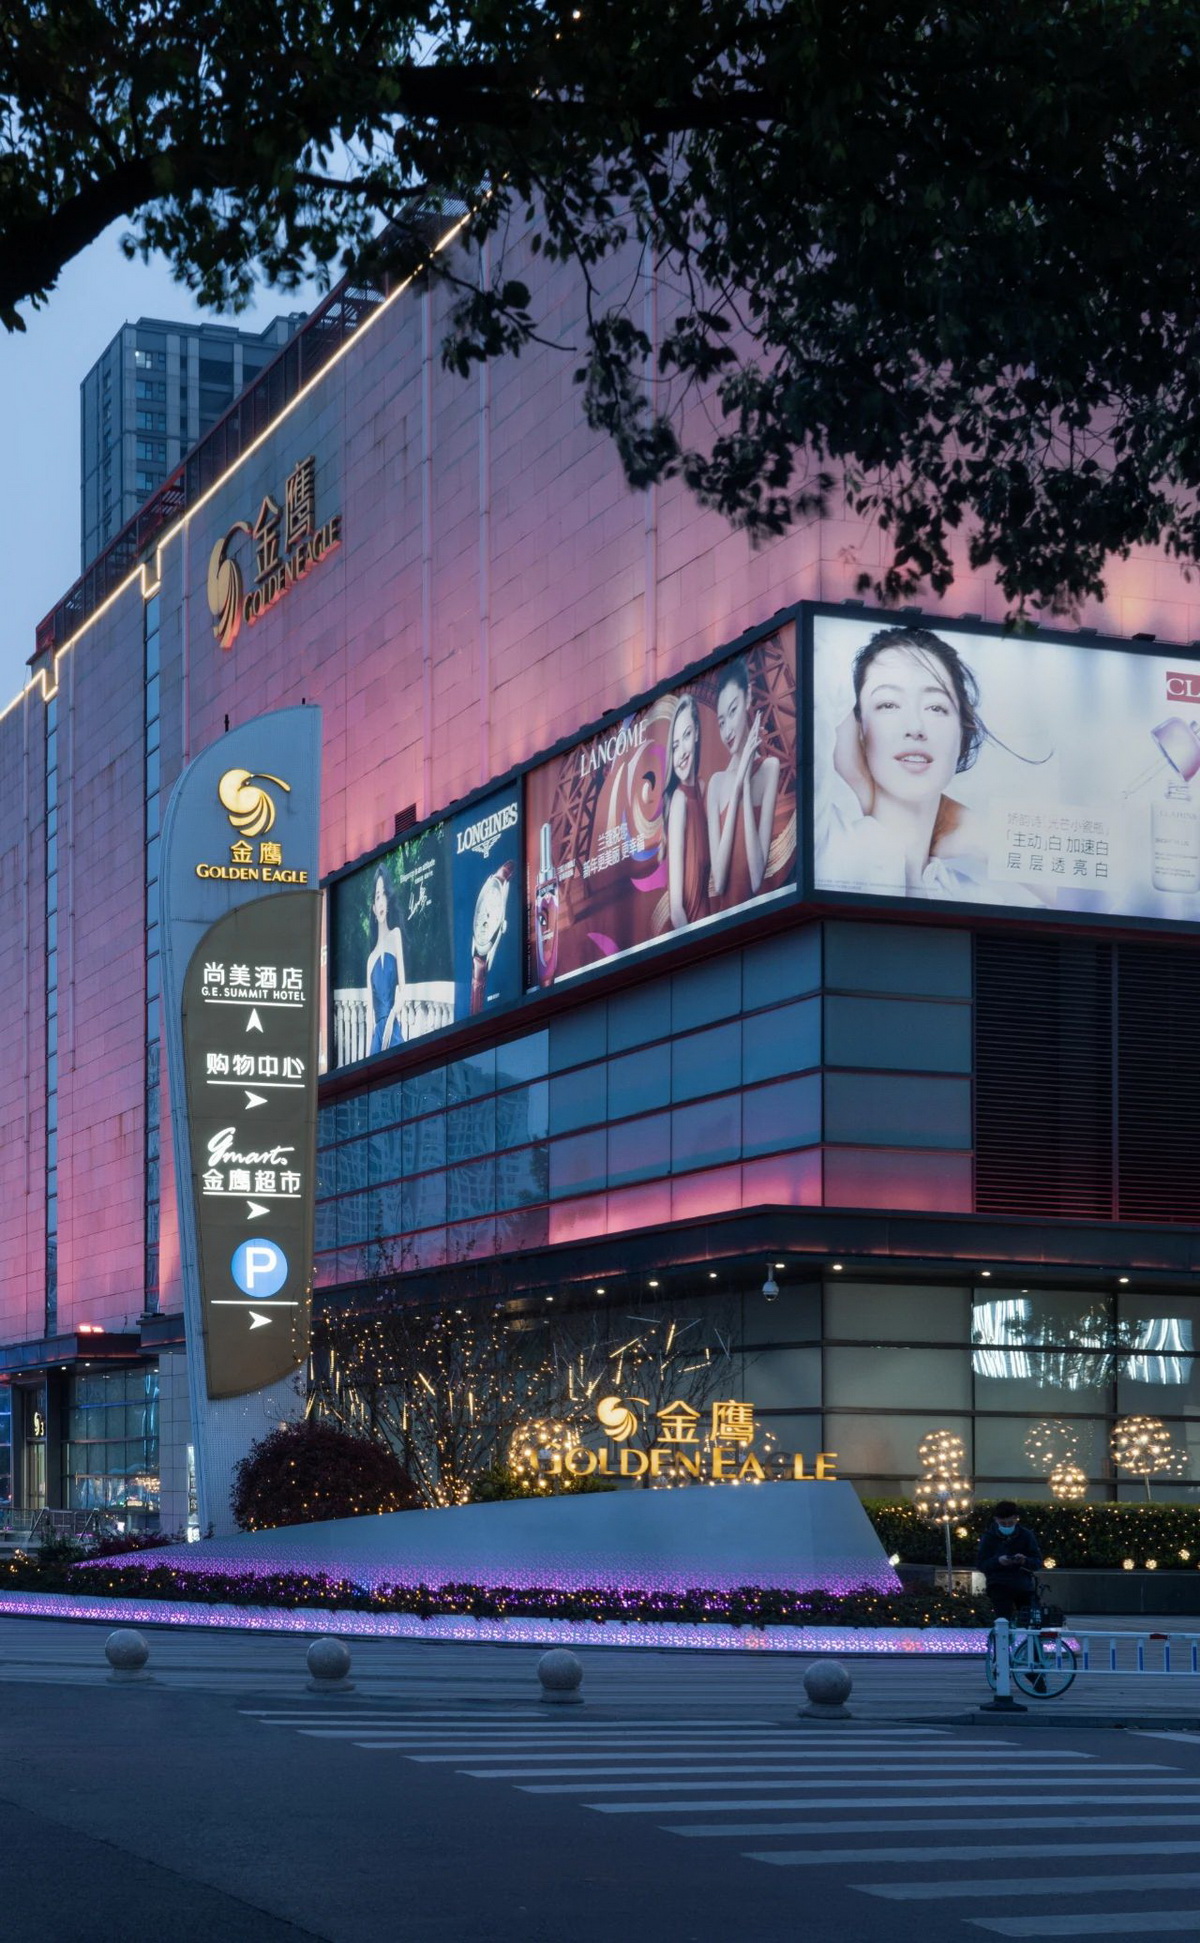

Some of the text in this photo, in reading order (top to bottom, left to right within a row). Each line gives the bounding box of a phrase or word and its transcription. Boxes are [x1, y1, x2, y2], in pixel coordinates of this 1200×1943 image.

[253, 455, 316, 583] 金鹰
[243, 515, 342, 624] GOLDEN EAGLE
[580, 719, 648, 778] LANCÔME
[456, 802, 519, 854] LONGINES
[230, 840, 282, 865] 金鹰
[196, 864, 308, 883] GOLDEN EAGLE
[203, 962, 303, 989] 尚美酒店
[224, 988, 268, 999] SUMMIT
[273, 990, 306, 1001] HOTEL
[206, 1053, 305, 1079] 购物中心
[202, 1168, 301, 1193] 金鹰超市
[246, 1246, 277, 1289] P
[656, 1399, 755, 1444] 金鹰
[530, 1444, 838, 1480] GOLDEN EAGLE
